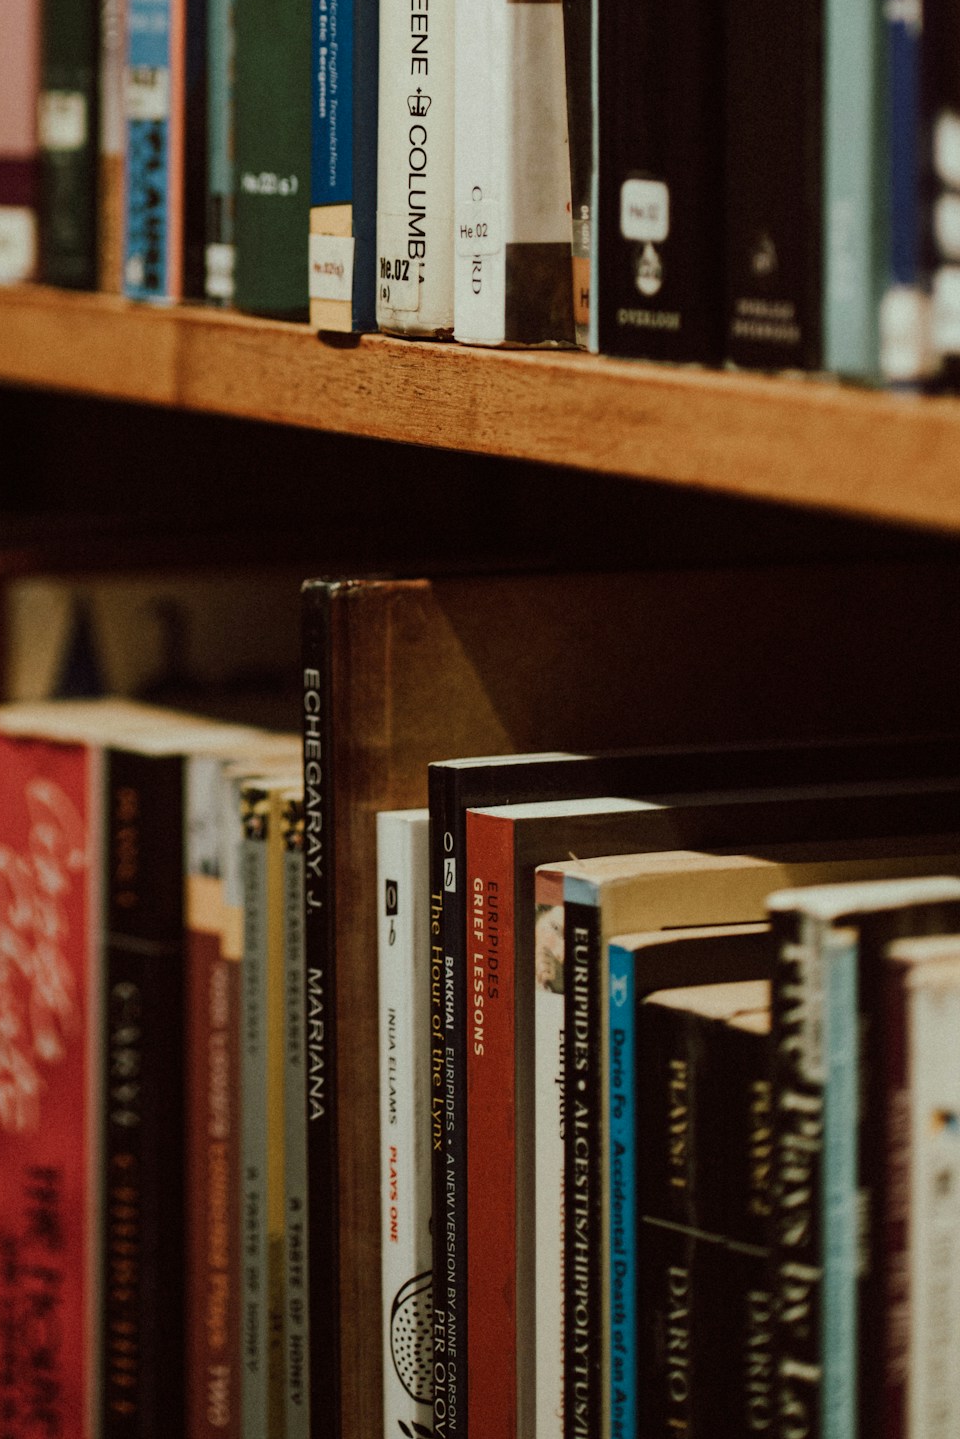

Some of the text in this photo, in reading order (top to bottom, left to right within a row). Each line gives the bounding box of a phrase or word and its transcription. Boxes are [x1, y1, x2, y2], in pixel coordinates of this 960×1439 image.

[380, 257, 410, 281] He.02
[460, 223, 488, 239] He.02
[473, 877, 485, 1057] GRIEF LESSONS
[487, 880, 499, 1000] EURIPIDES
[307, 967, 326, 1121] MARIANA
[429, 890, 445, 1152] The Hour of the Lynx
[613, 1028, 626, 1089] Dario
[613, 1093, 627, 1120] Fo
[388, 1144, 399, 1243] PLAYS ONE
[444, 955, 457, 1431] BAKKHAI EURIPIDES A NEW VERSION BY ANNE CARSON
[573, 926, 590, 1439] EURIPIDES ALCESTIS/HIPPOLYTUS/I
[613, 1139, 628, 1255] Accidental
[433, 1308, 446, 1354] PER
[613, 1261, 627, 1327] Death
